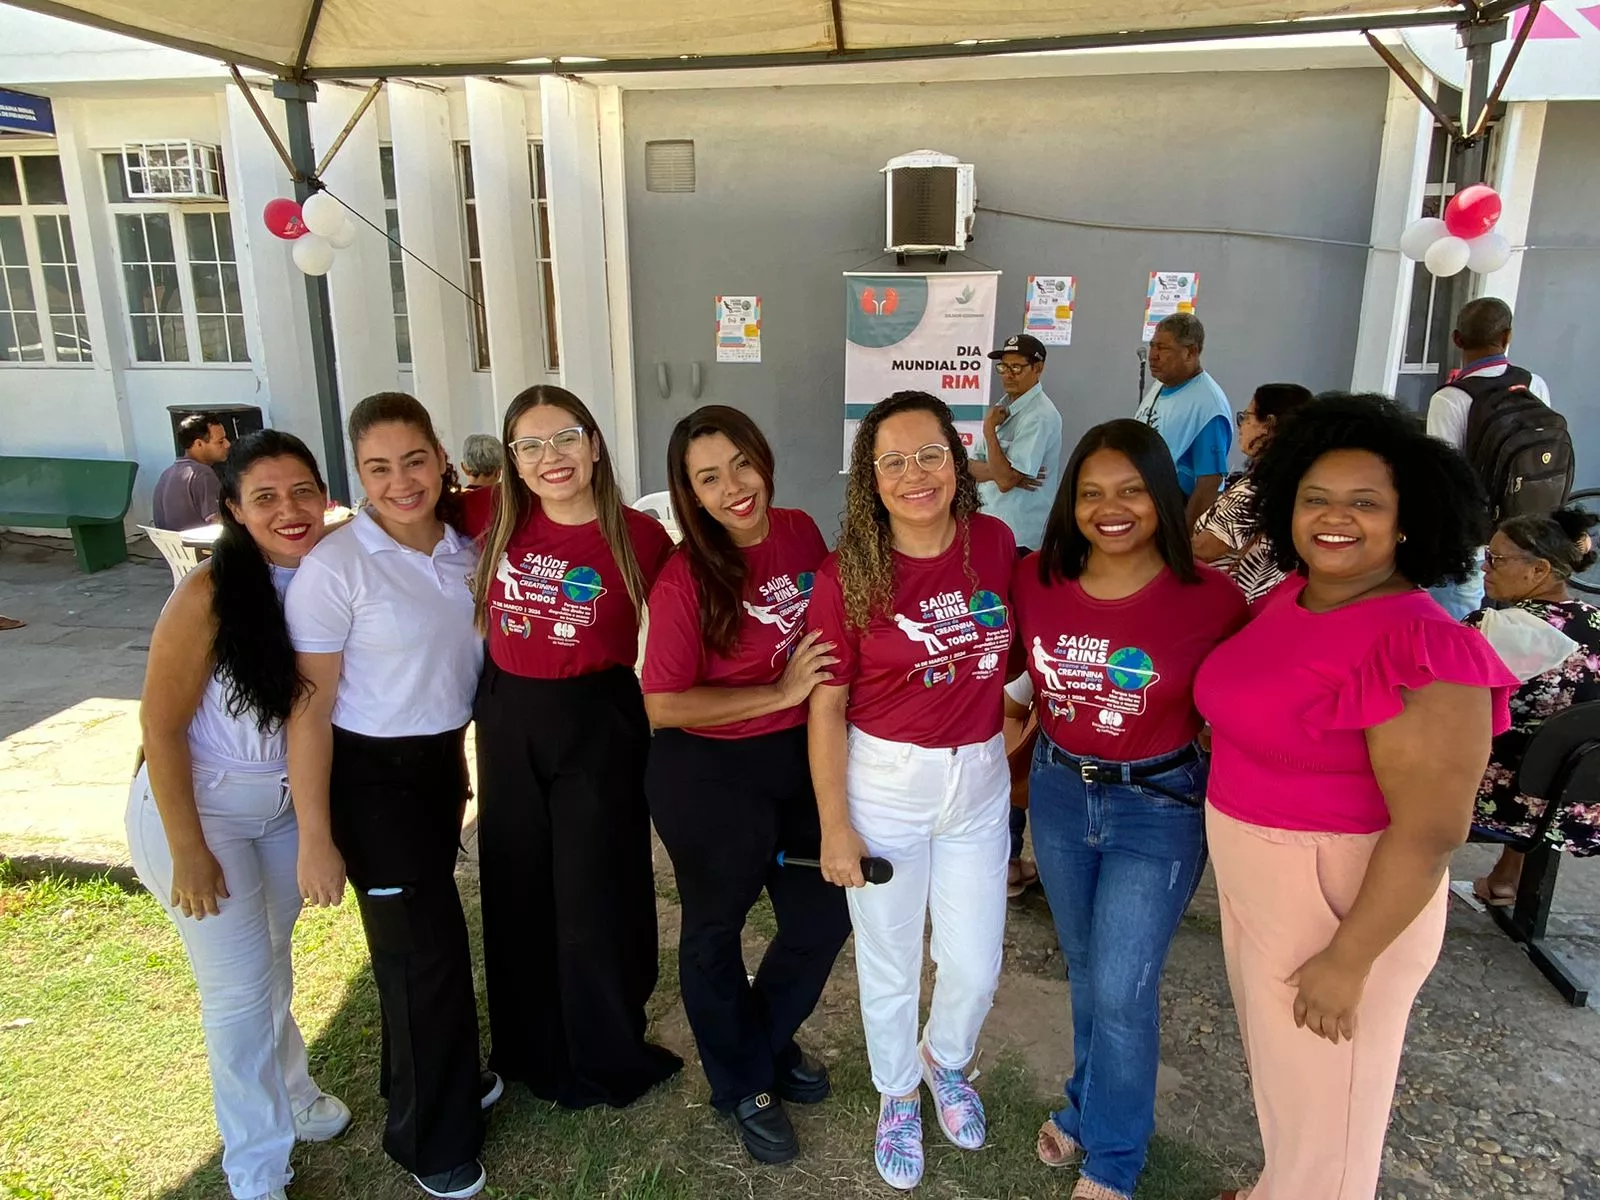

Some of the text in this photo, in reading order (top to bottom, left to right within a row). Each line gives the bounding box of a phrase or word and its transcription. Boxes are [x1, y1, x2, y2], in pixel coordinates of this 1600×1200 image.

[956, 346, 981, 357] DIA
[892, 360, 981, 371] MUNDIAL DO
[941, 375, 980, 389] RIM
[524, 553, 568, 570] SAÚDE
[531, 566, 565, 580] RINS
[520, 580, 558, 592] CREATININA
[759, 574, 792, 596] SAÚDE
[525, 592, 556, 605] TODOS
[774, 585, 799, 602] RINS
[504, 603, 523, 612] MARÇO
[919, 591, 964, 612] SAÚDE
[935, 603, 968, 620] RINS
[935, 621, 975, 636] CREATININA
[947, 632, 979, 647] TODOS
[1057, 635, 1110, 651] SAÚDE
[1067, 648, 1107, 664] RINS
[1057, 669, 1104, 679] CREATININA
[1066, 681, 1102, 691] TODOS
